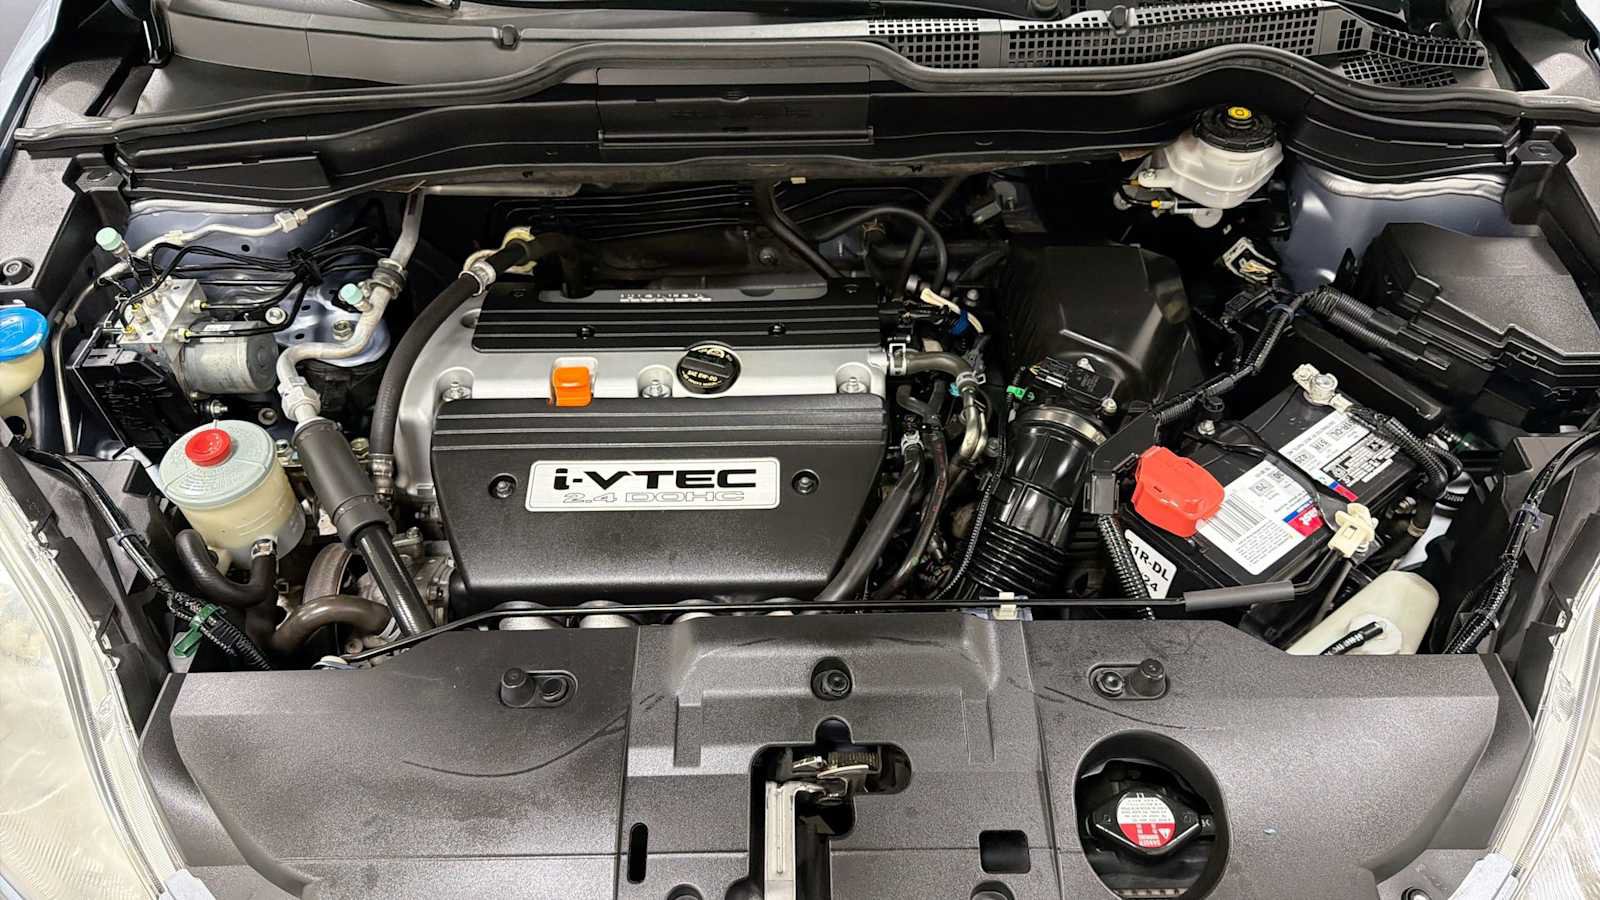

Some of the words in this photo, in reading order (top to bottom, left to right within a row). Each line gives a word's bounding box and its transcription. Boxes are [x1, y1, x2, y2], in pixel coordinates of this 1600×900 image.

[553, 468, 757, 490] i-VTEC
[562, 491, 617, 504] 2.4
[625, 490, 745, 503] DOHC
